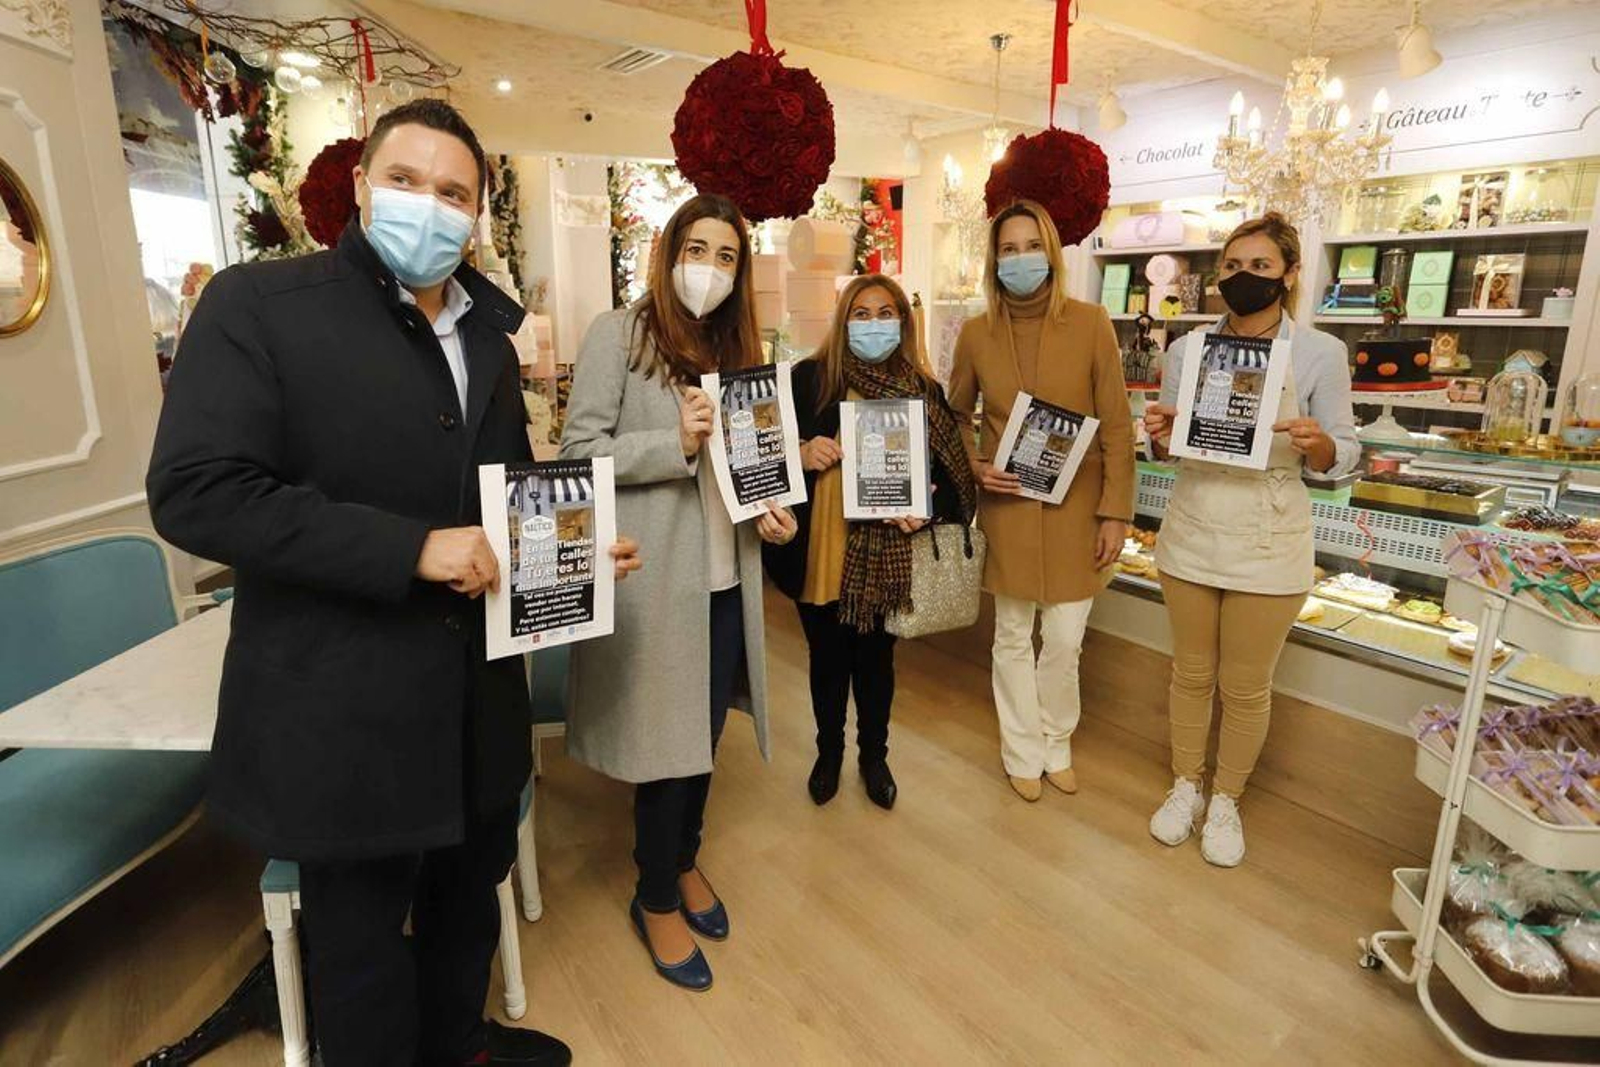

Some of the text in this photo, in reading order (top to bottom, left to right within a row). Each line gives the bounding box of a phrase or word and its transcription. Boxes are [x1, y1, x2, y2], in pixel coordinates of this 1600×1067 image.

[1386, 104, 1468, 130] Gâteau
[1136, 141, 1204, 165] Chocolat
[1230, 399, 1259, 408] calles
[1243, 407, 1253, 417] lo
[527, 544, 538, 554] En
[557, 536, 594, 548] Tiendas
[523, 547, 594, 566] de tus calles
[545, 563, 573, 575] eres
[577, 560, 588, 571] lo
[540, 573, 593, 589] importante
[524, 599, 547, 608] vender
[561, 593, 583, 602] barato
[540, 606, 552, 615] por
